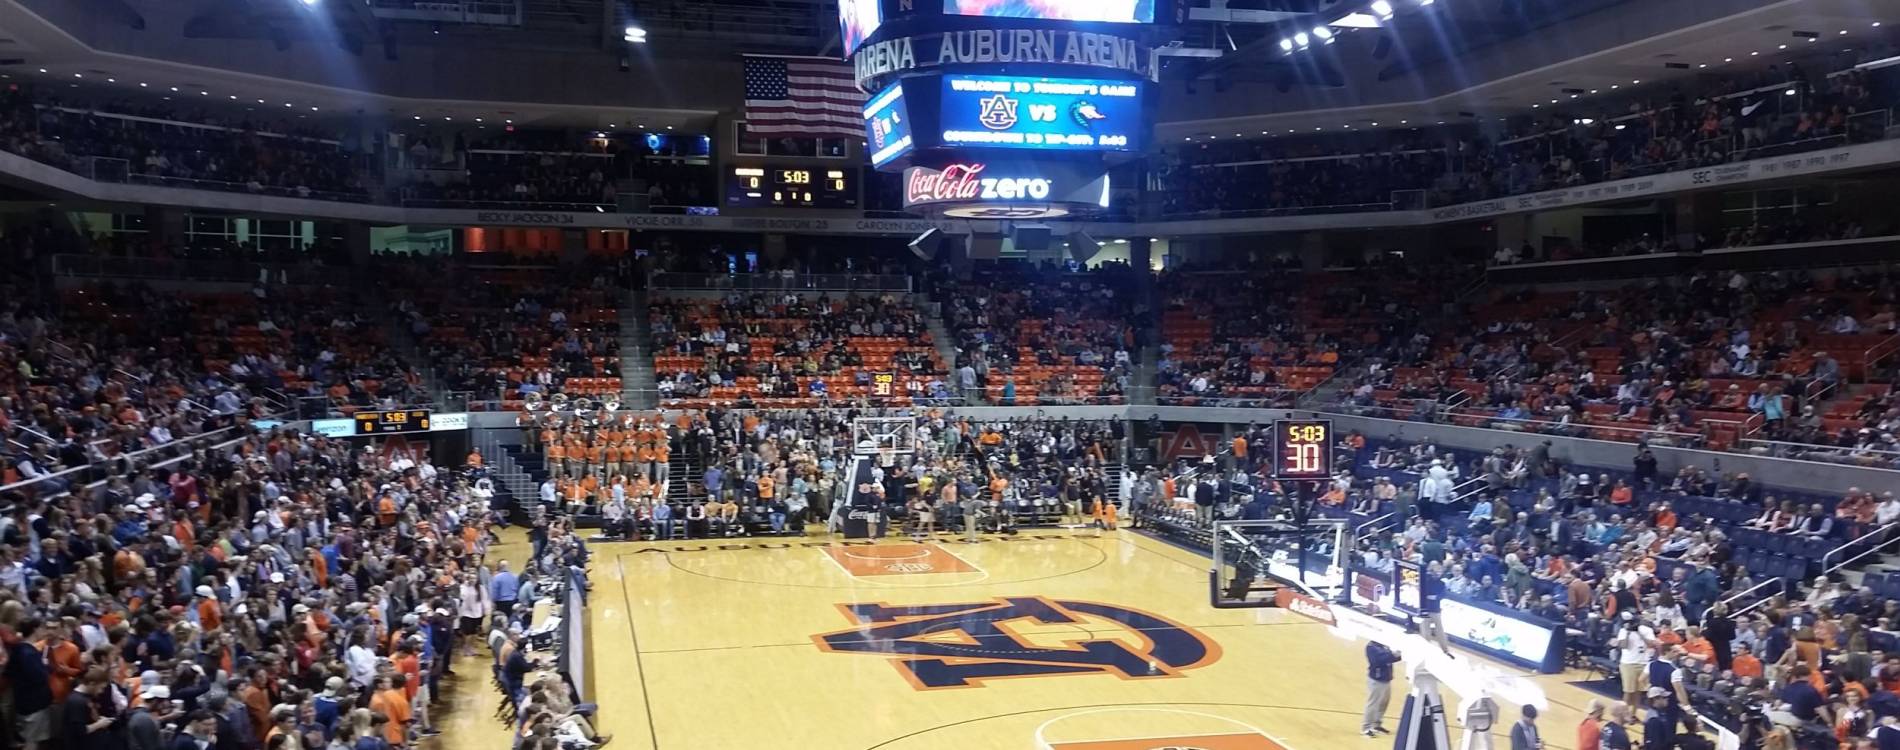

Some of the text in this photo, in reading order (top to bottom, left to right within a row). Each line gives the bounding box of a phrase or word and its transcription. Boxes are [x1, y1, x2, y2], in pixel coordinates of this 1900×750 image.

[860, 36, 916, 80] ARENA
[938, 29, 1055, 63] AUBURN
[1062, 31, 1138, 73] ARENA
[951, 80, 1011, 92] WELCOME
[1014, 82, 1031, 93] TO
[1100, 86, 1136, 96] GAME
[750, 177, 758, 188] 0
[784, 171, 809, 183] 5:03
[836, 179, 843, 190] 0
[1692, 171, 1711, 184] SEC
[981, 178, 1049, 199] zero
[478, 212, 509, 222] BECKY
[512, 213, 559, 224] JACKSON
[1290, 426, 1325, 442] 5:03
[1286, 444, 1319, 472] 30
